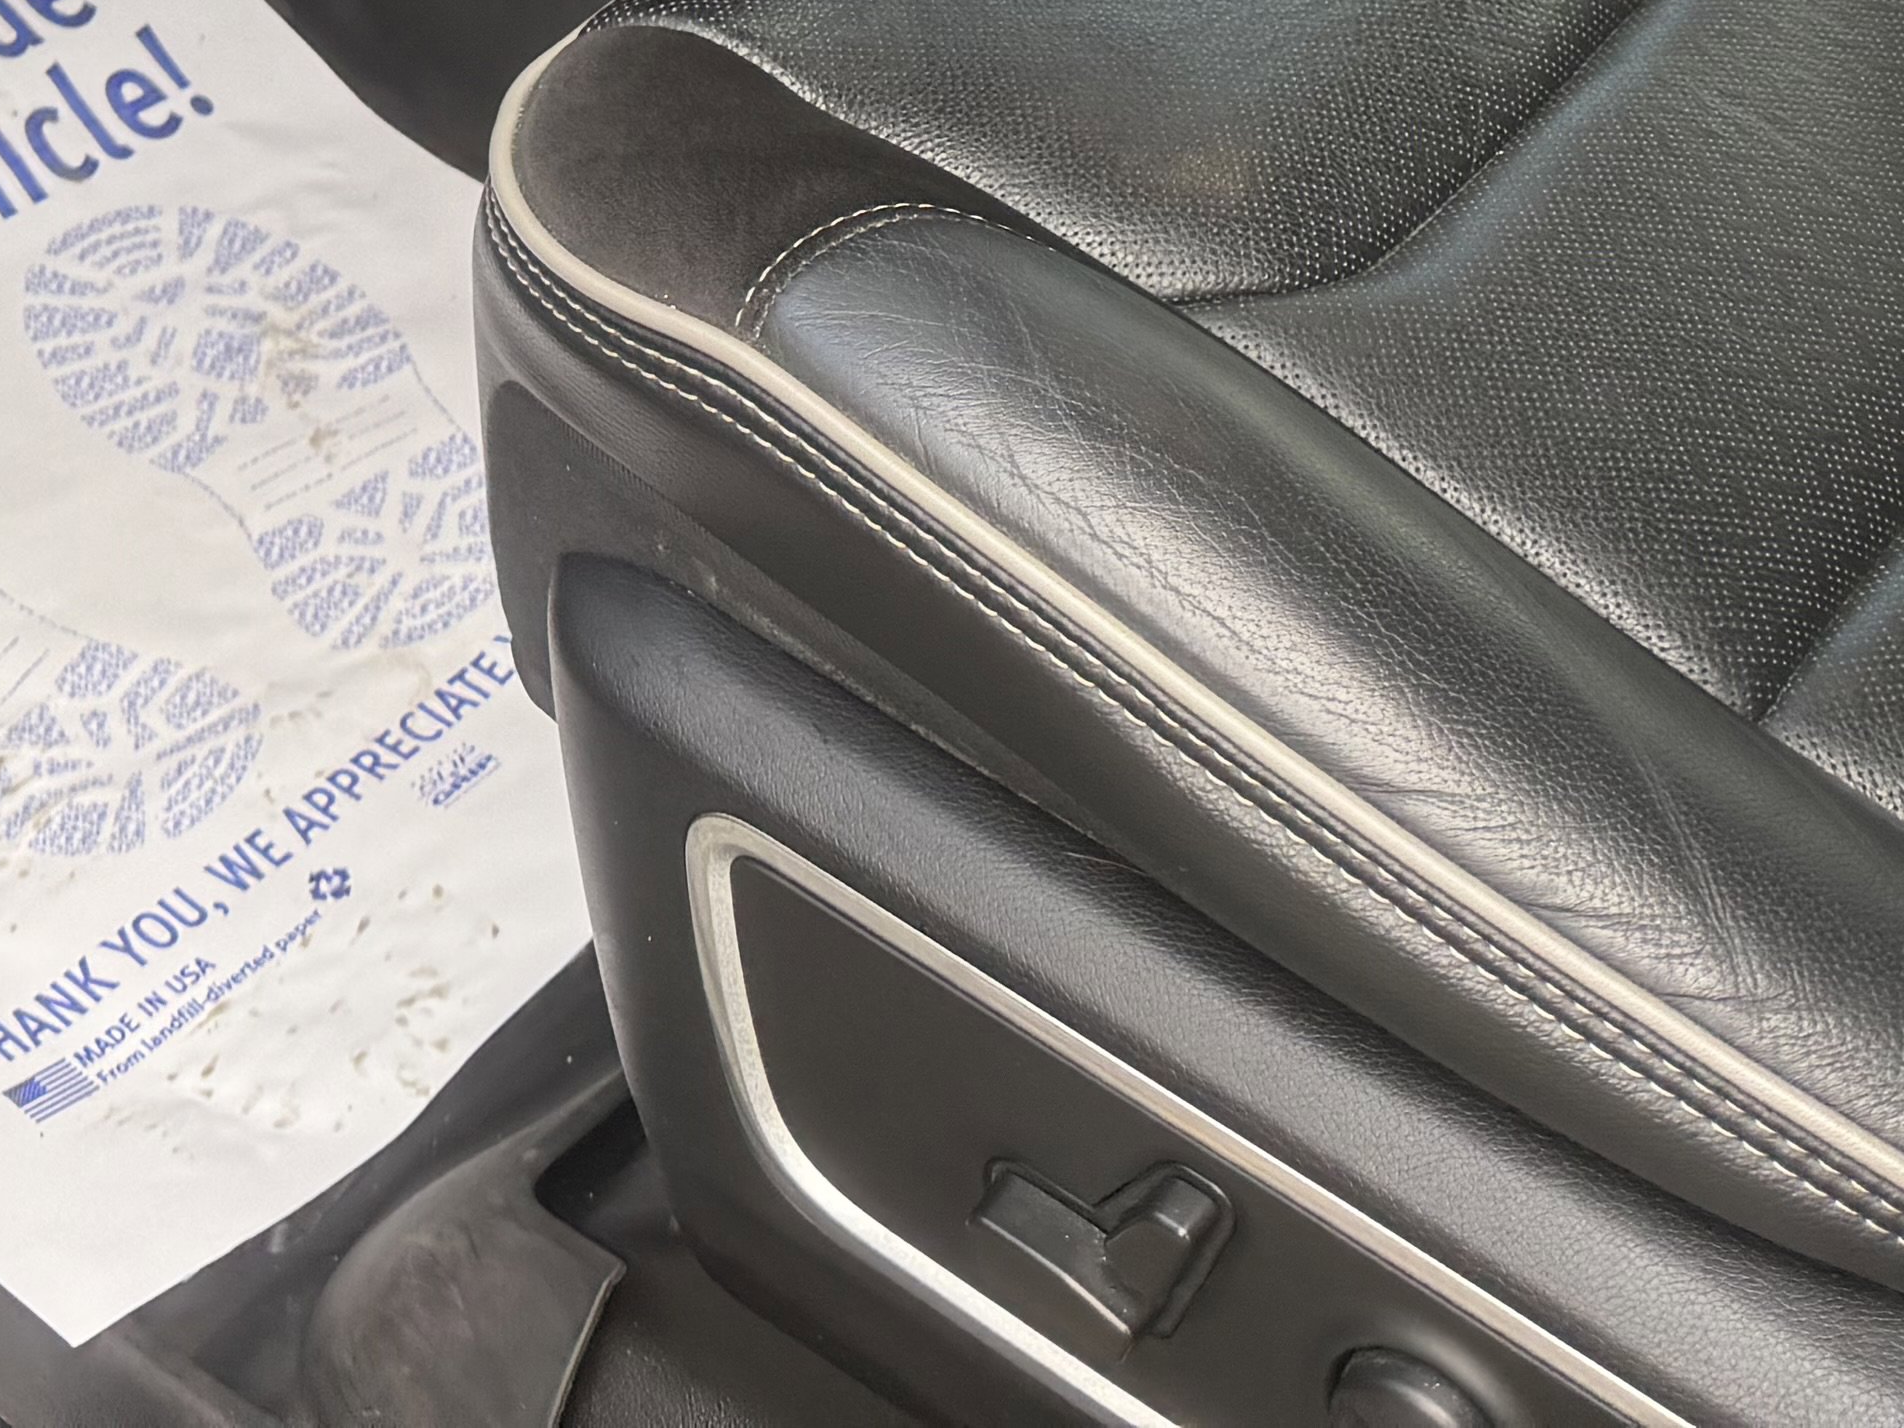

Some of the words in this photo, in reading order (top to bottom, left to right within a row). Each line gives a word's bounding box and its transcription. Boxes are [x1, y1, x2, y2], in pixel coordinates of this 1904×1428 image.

[99, 886, 231, 967] YOU,
[202, 828, 295, 893] WE
[281, 650, 516, 846] APPRECIATE
[72, 1010, 142, 1070] MADE
[137, 989, 169, 1021] IN
[164, 956, 217, 995] USA
[96, 1050, 147, 1087] From
[145, 945, 276, 1053] landfill-diverted
[274, 907, 324, 953] paper
